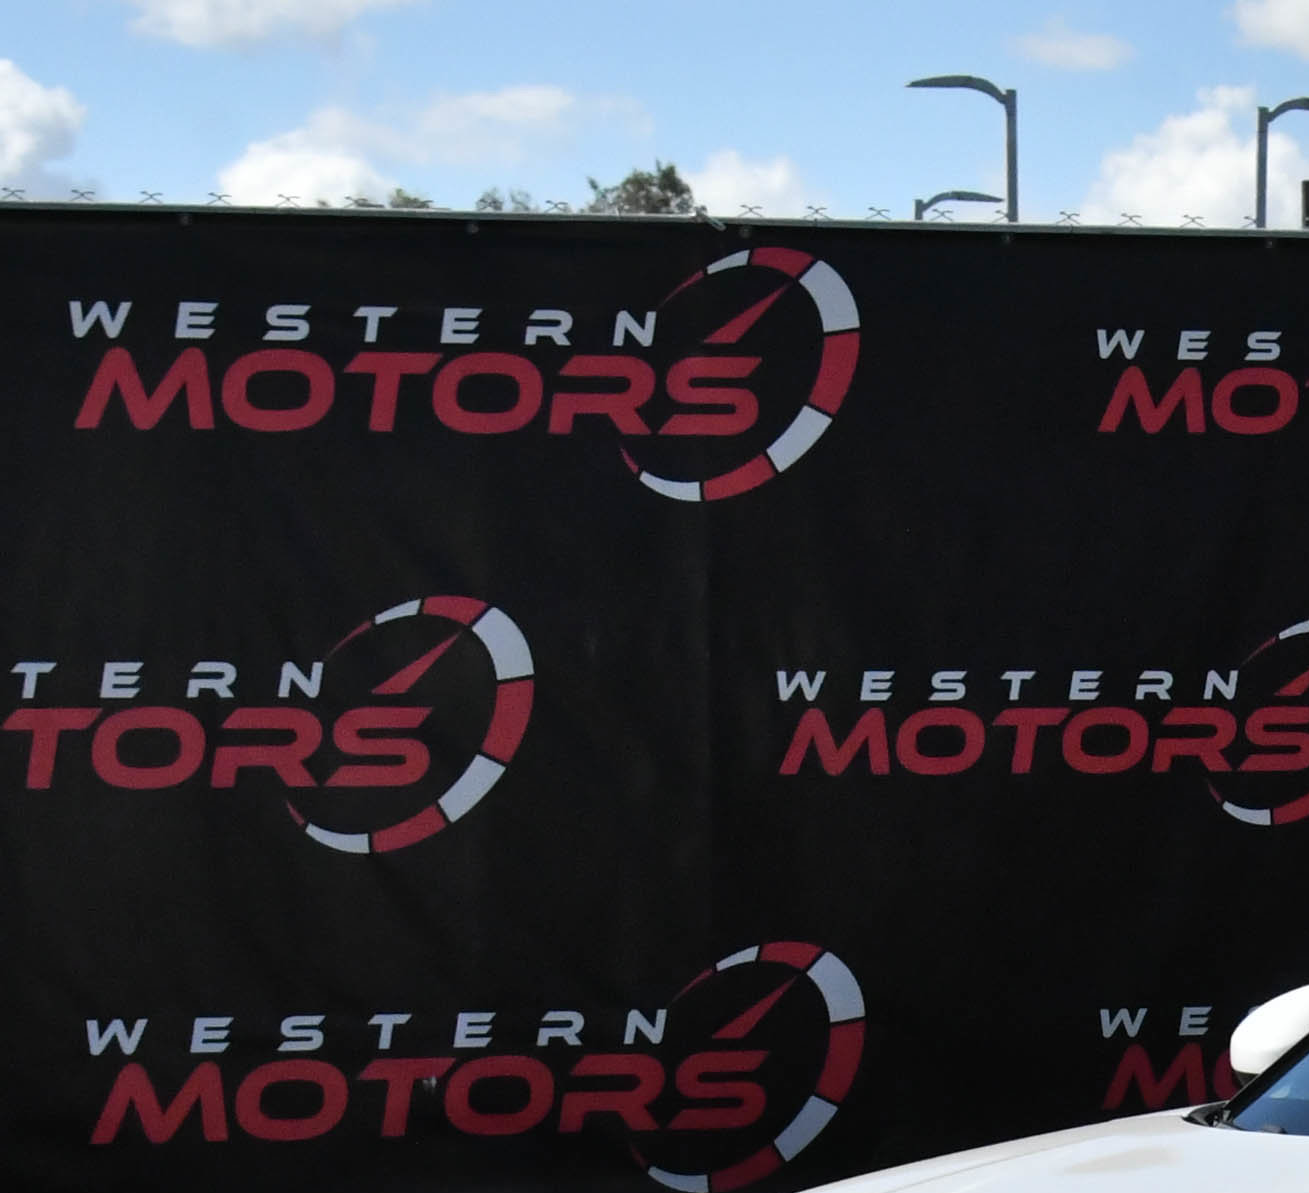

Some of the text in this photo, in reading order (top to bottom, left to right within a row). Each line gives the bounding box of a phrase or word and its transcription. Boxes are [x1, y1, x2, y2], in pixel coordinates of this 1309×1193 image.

[70, 302, 656, 346] WESTERN
[76, 348, 760, 435] MOTORS
[12, 662, 323, 698] TERN
[777, 671, 1238, 701] WESTERN
[4, 707, 429, 789] TORS
[87, 1010, 666, 1055] WESTERN
[94, 1052, 765, 1144] MOTORS
